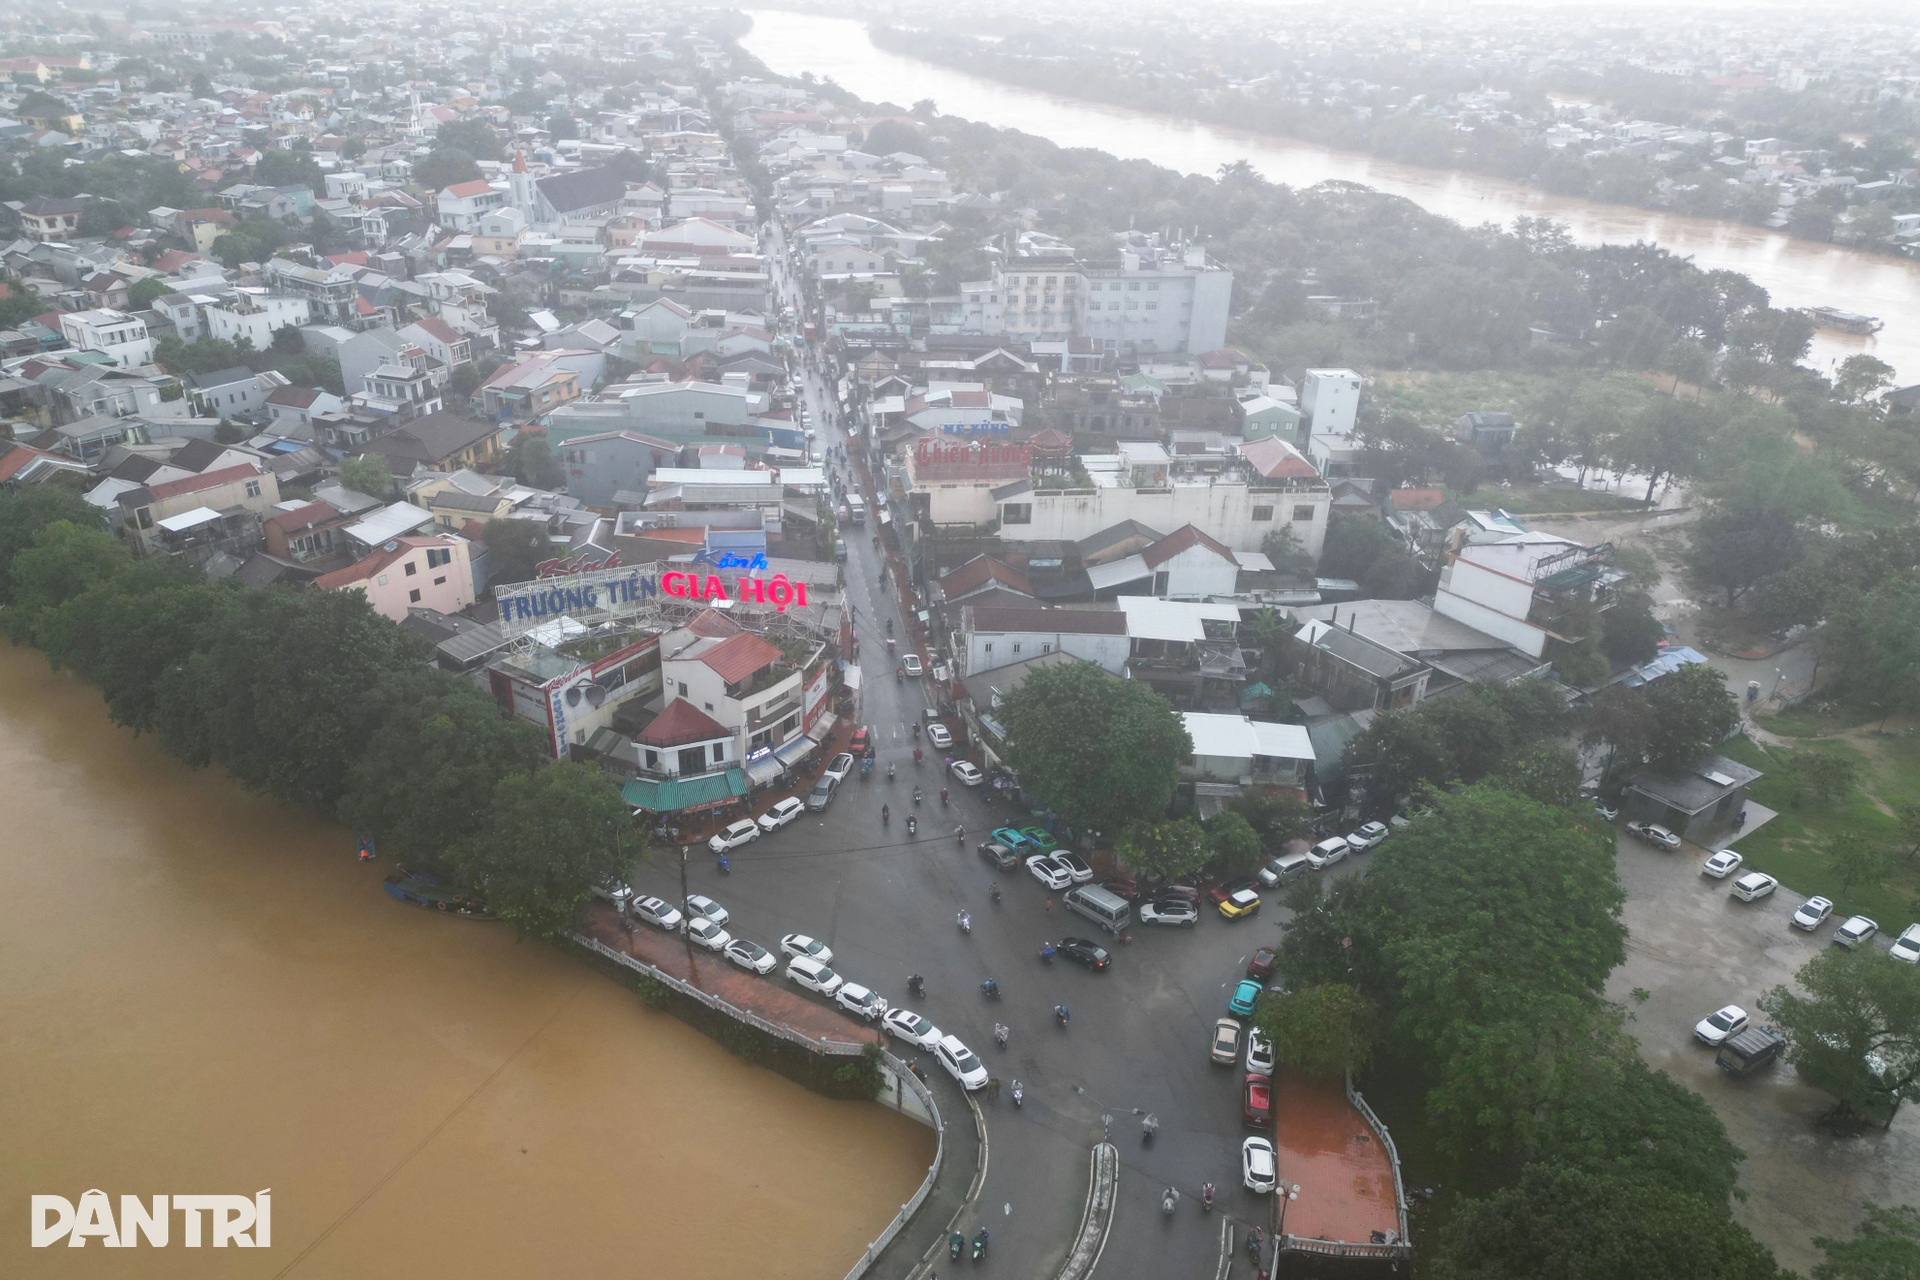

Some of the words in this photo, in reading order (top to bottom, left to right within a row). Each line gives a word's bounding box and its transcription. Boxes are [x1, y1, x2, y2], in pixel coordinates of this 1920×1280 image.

[497, 584, 598, 622] TRƯỜNG
[604, 567, 657, 604] TIỀN
[661, 571, 728, 601] GIA
[738, 573, 809, 612] HỘI
